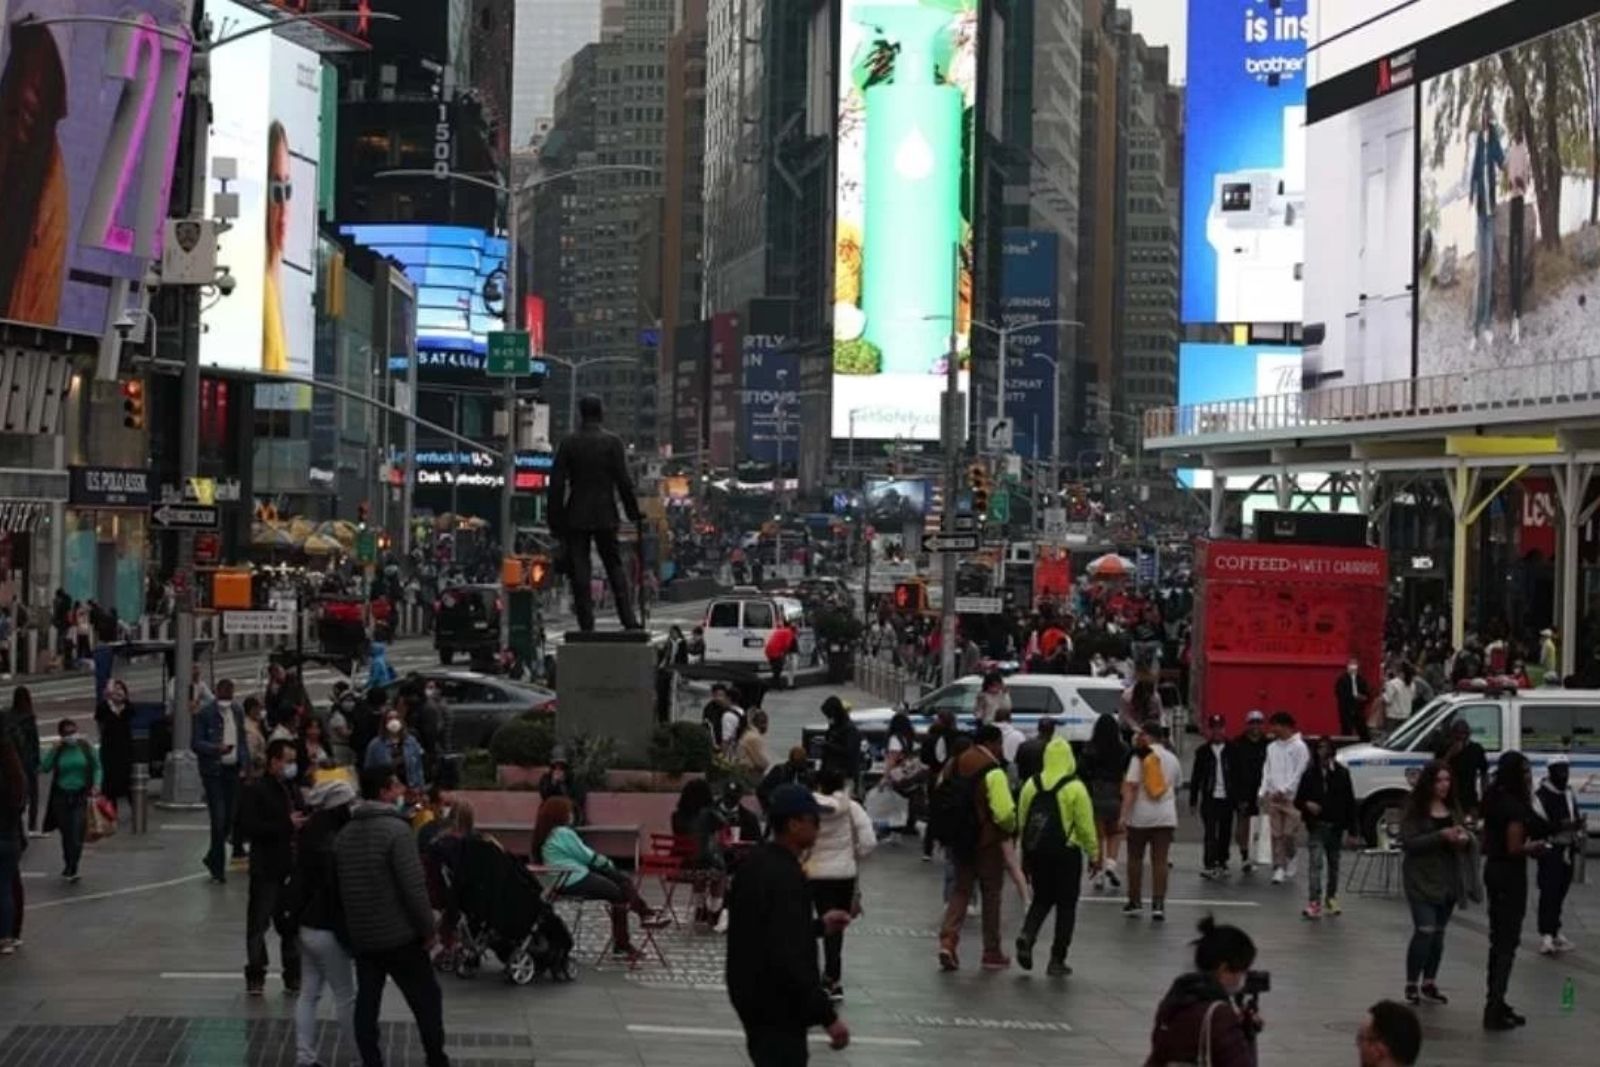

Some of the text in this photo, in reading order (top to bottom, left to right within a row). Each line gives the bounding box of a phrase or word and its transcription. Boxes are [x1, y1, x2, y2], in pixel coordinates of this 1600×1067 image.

[1246, 9, 1268, 42] is
[1247, 58, 1303, 72] brother
[434, 104, 449, 179] 1500
[1214, 556, 1291, 571] COFFEED
